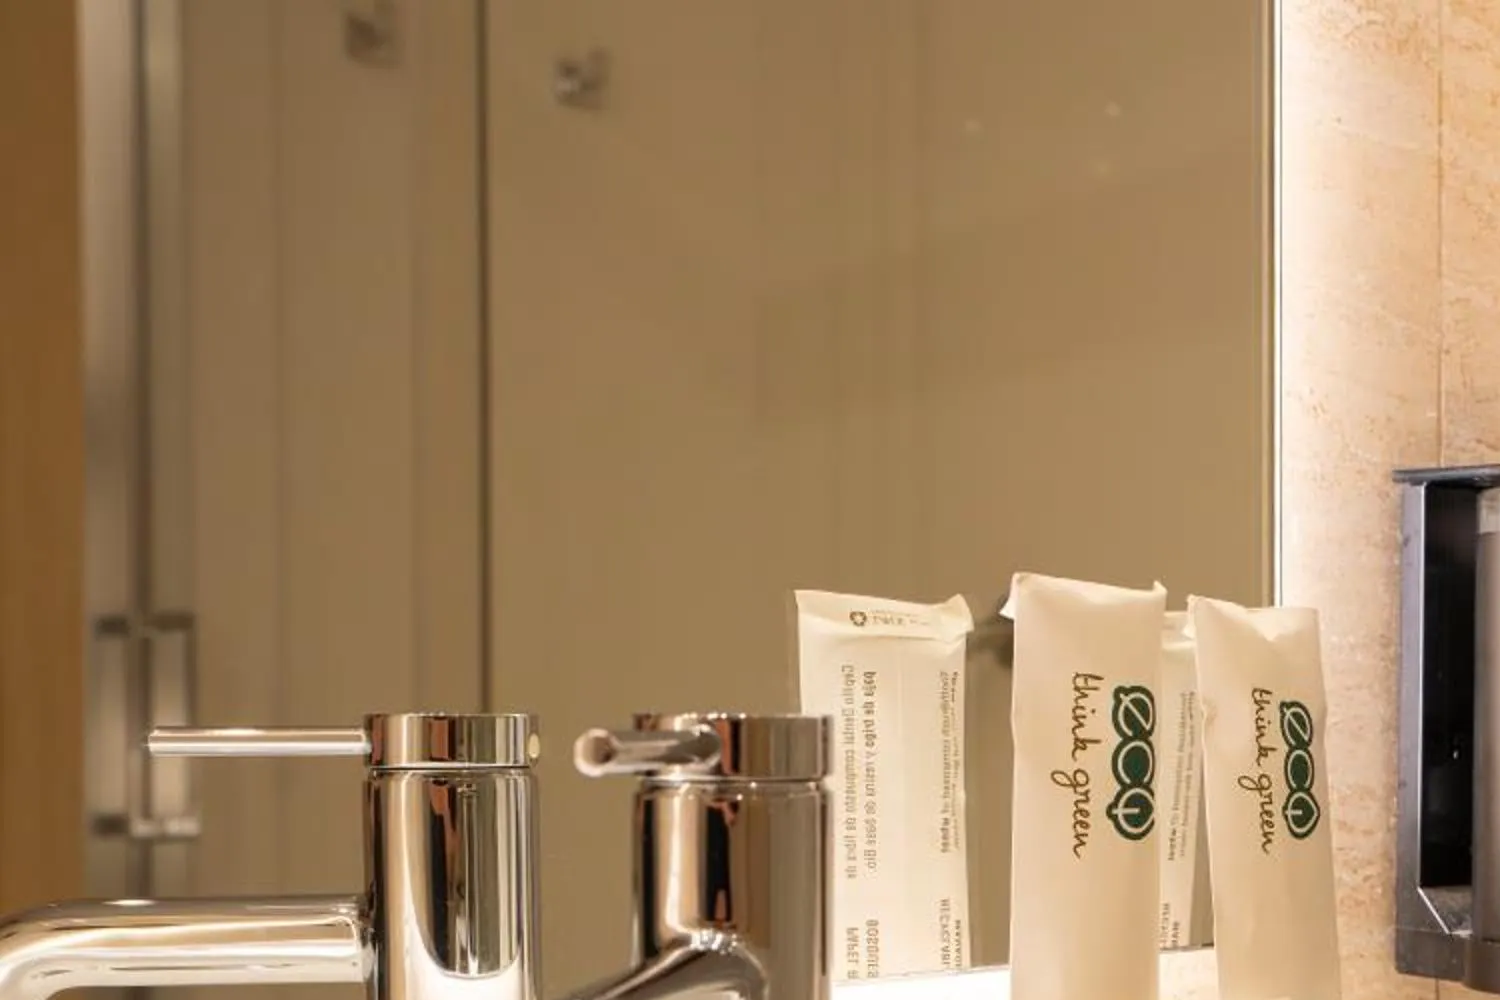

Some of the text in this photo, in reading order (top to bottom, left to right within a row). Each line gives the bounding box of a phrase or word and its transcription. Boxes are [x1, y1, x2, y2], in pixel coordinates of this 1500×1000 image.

[1050, 671, 1104, 859] think green
[1238, 687, 1278, 855] think green
